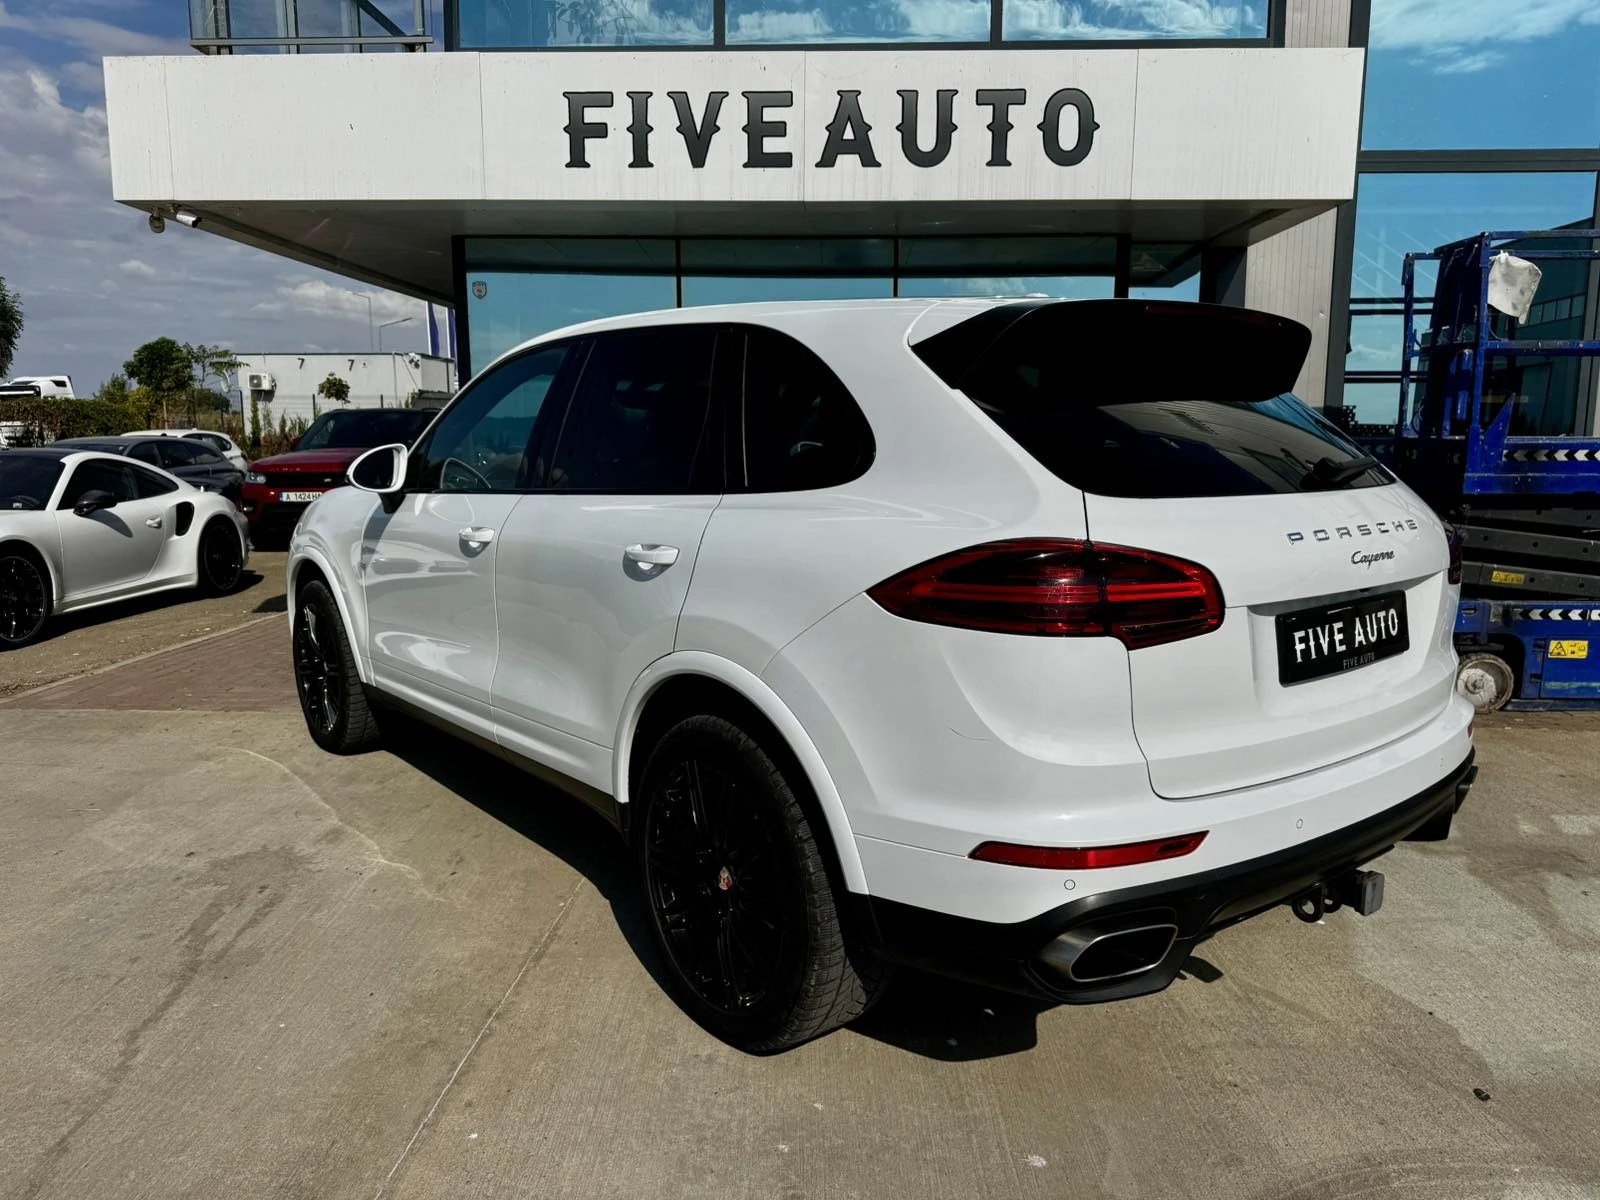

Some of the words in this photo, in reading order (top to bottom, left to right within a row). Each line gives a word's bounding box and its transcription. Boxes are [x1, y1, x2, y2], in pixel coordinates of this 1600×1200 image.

[1287, 519, 1418, 545] PORSCHE
[1350, 550, 1395, 569] Cayenne
[1293, 621, 1347, 663] FIVE
[1355, 608, 1398, 648] AUTO
[1343, 656, 1358, 669] FIVE
